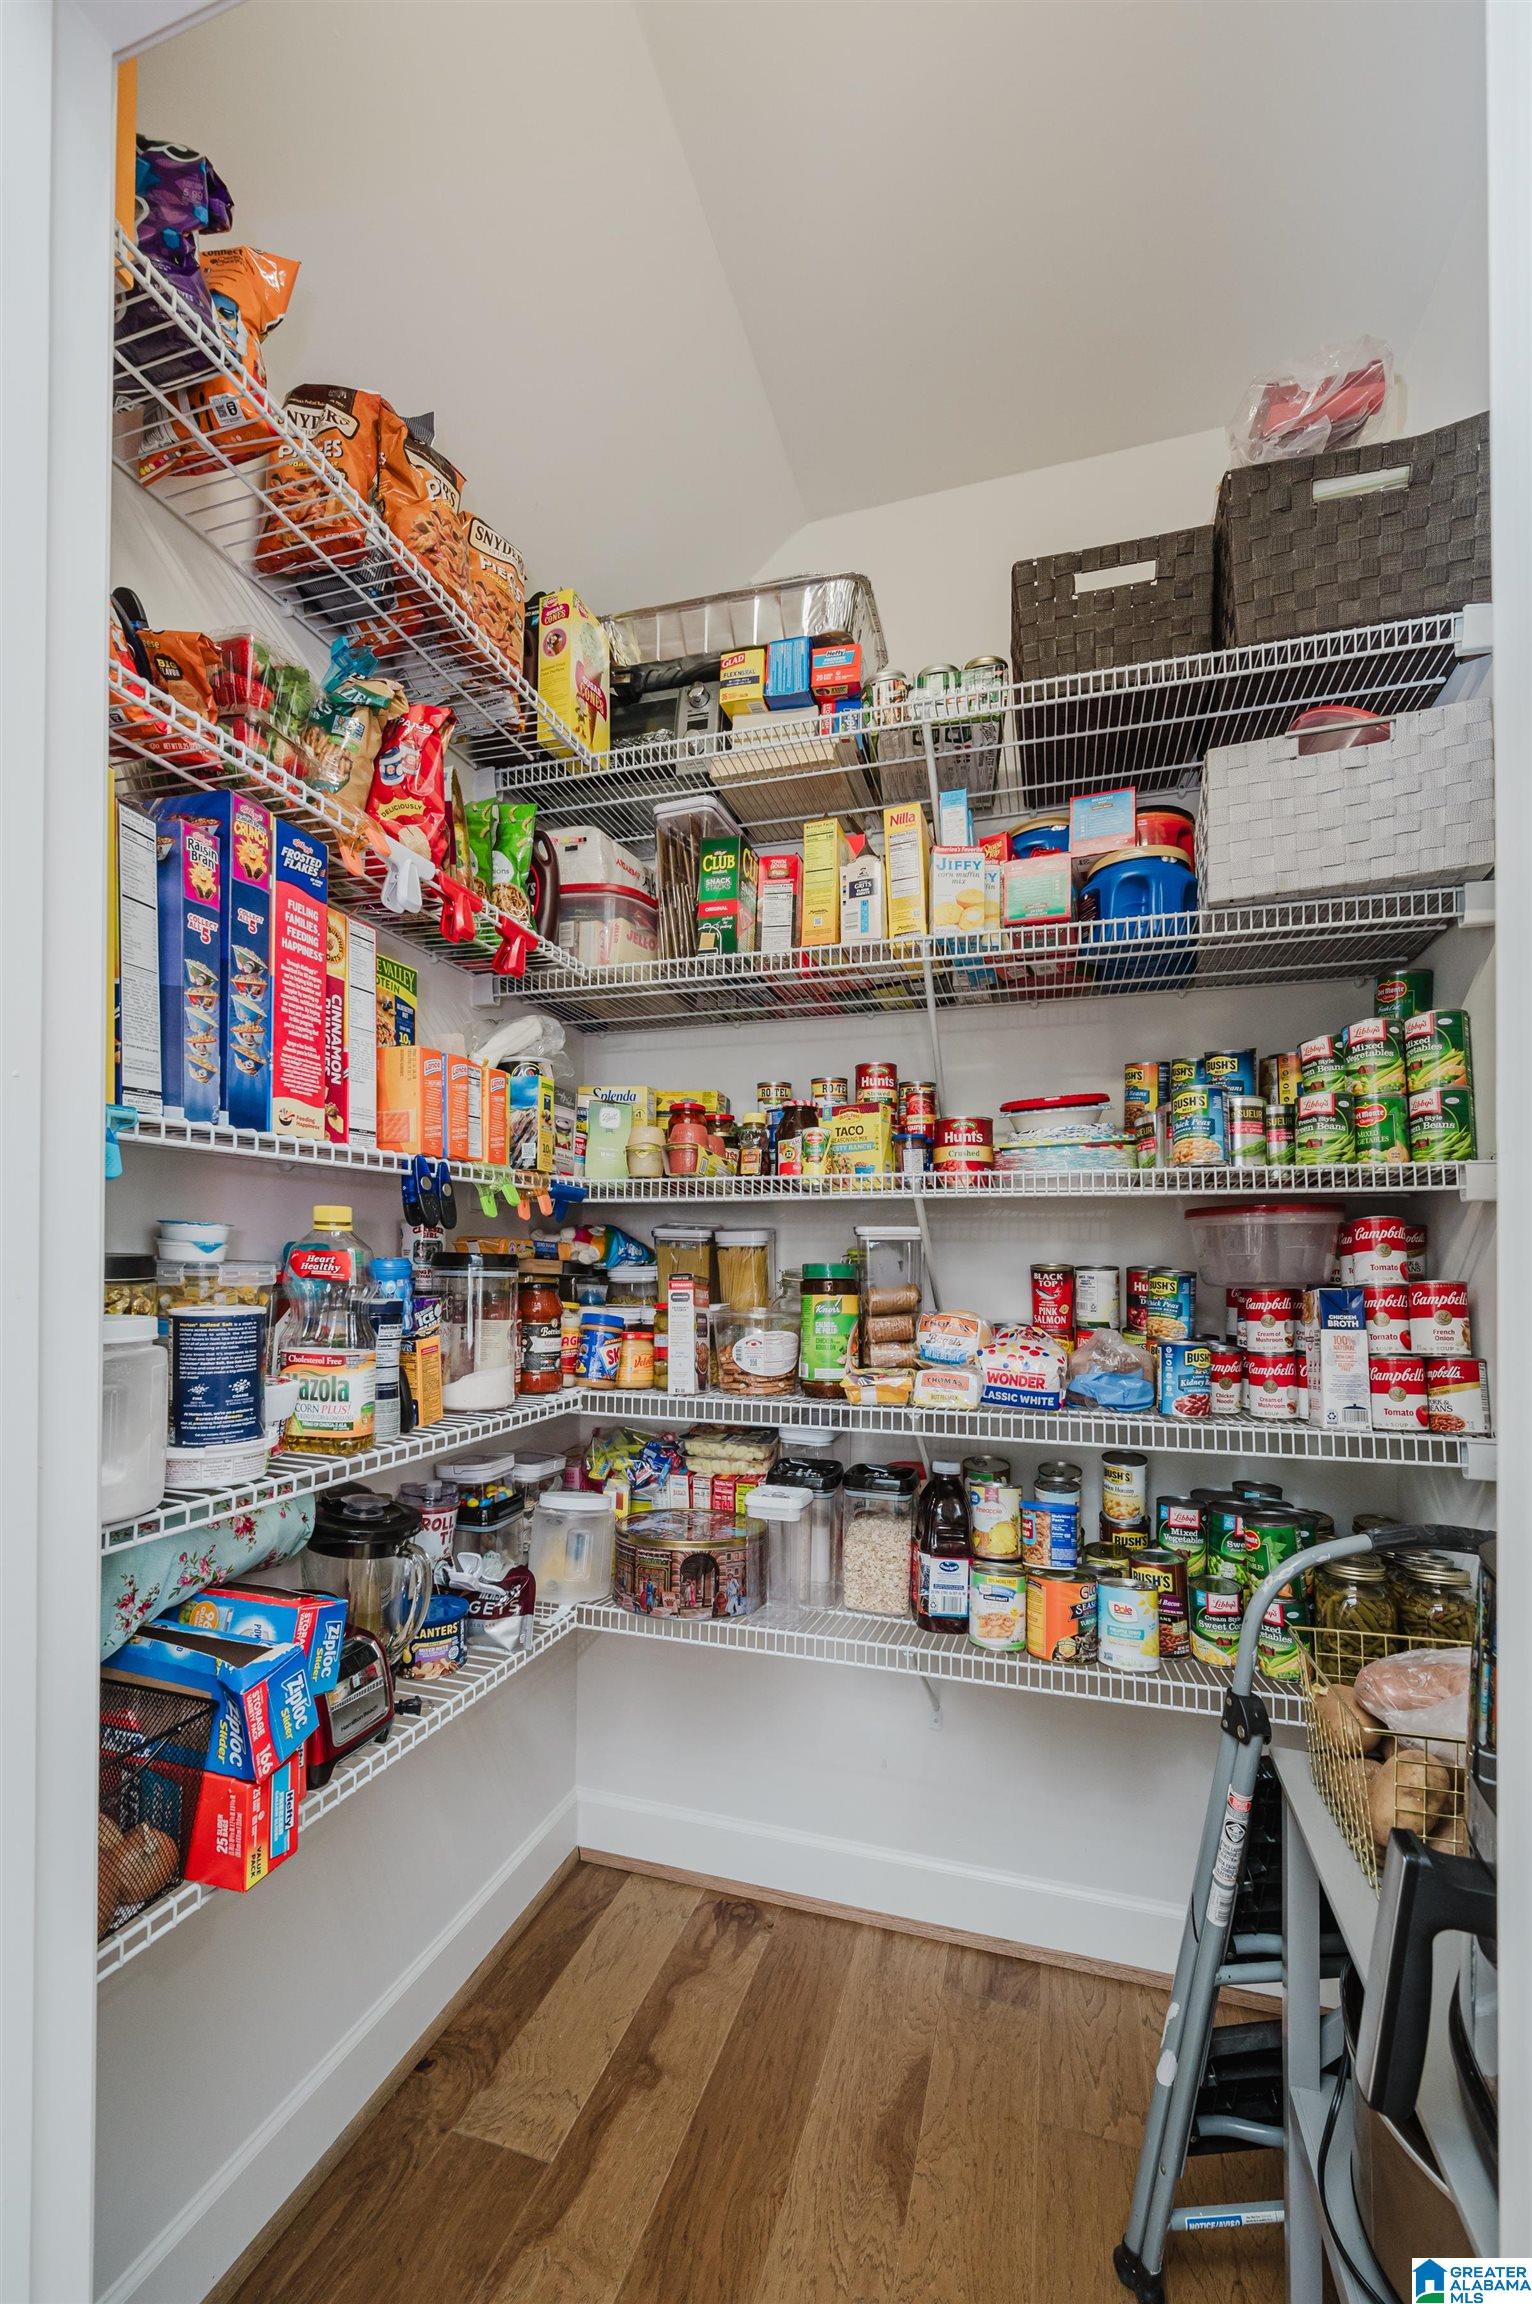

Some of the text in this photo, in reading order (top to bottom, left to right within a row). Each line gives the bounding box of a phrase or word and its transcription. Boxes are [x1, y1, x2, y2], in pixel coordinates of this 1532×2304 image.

[156, 658, 178, 669] BIG
[721, 655, 745, 668] GLAD
[381, 803, 422, 818] DELICIOUSLY
[889, 811, 916, 828] Nilla
[233, 821, 269, 849] CRUNCH
[187, 837, 218, 861] Raisin
[191, 852, 216, 870] Bran
[280, 847, 322, 868] FROSTED
[702, 854, 736, 873] CLUB
[936, 857, 983, 871] JIFFY
[283, 858, 319, 877] FLAKES
[704, 876, 732, 885] SNACK
[955, 871, 980, 880] muffin
[853, 879, 872, 890] GRITS
[238, 908, 265, 924] COLLECT
[287, 899, 320, 920] FUELING
[187, 913, 219, 932] COLLECT
[248, 921, 258, 933] 5
[200, 927, 211, 943] 5
[286, 926, 320, 948] FEEDING
[281, 937, 324, 962] HAPPINESS
[382, 960, 416, 993] VALLEY
[1385, 986, 1405, 996] Monte
[1353, 1025, 1381, 1038] Libby's
[1405, 1020, 1428, 1035] Libby's
[331, 994, 343, 1085] CINNAMON
[1303, 1044, 1326, 1056] Libby's
[1351, 1041, 1385, 1054] Mixed
[1318, 1058, 1335, 1067] Style
[1346, 1050, 1395, 1064] Vegetables
[425, 1060, 441, 1071] Lance
[452, 1066, 467, 1076] Lance
[1206, 1059, 1237, 1072] BUSH'S
[1317, 1062, 1346, 1073] Beans
[491, 1078, 506, 1089] Lance
[593, 1087, 637, 1102] Splenda
[1173, 1095, 1206, 1111] BUSH'S
[1303, 1098, 1329, 1111] Libby's
[1411, 1098, 1434, 1111] Libby's
[1318, 1115, 1336, 1123] Style
[1360, 1109, 1384, 1119] Monte
[1424, 1114, 1443, 1123] Style
[1191, 1118, 1211, 1127] Peas
[1316, 1122, 1346, 1133] Beans
[1422, 1122, 1456, 1131] Beans
[835, 1125, 864, 1137] TACO
[944, 1130, 984, 1143] Hunt's
[306, 1254, 336, 1264] Heart
[300, 1262, 341, 1273] Healthy
[1370, 1262, 1400, 1272] Tomato
[1033, 1272, 1064, 1281] BLACK
[1039, 1279, 1058, 1287] TOP
[1149, 1279, 1177, 1292] BUSH'S
[1163, 1301, 1180, 1309] Peas
[1246, 1298, 1293, 1312] Campbell's
[1364, 1294, 1408, 1309] ampbell's
[1411, 1292, 1469, 1306] Campbell's
[815, 1304, 841, 1314] Knorr
[1038, 1306, 1058, 1316] PINK
[1034, 1314, 1067, 1325] SALMON
[1327, 1320, 1360, 1329] BROTH
[1370, 1333, 1398, 1341] Tomato
[1432, 1328, 1456, 1336] French
[925, 1333, 963, 1347] Bagels
[1332, 1335, 1356, 1346] 100%
[287, 1354, 343, 1366] Cholesterol Free
[1248, 1362, 1297, 1377] Campbell's
[1370, 1366, 1425, 1383] Campbell's
[986, 1371, 1046, 1389] WONDER
[1180, 1378, 1203, 1388] Kidney
[1019, 1392, 1055, 1406] WHITE
[294, 1402, 352, 1415] CORN PLUS!
[1383, 1408, 1415, 1417] Tomato
[1104, 1468, 1132, 1482] BUSH'S
[1114, 1485, 1135, 1494] Hominy
[1174, 1512, 1197, 1522] Libby's
[1170, 1527, 1198, 1536] Mixed
[1114, 1534, 1149, 1548] BUSH'S
[1163, 1533, 1204, 1544] Vegetables
[1132, 1570, 1171, 1589] BUSH'S
[1113, 1605, 1133, 1616] Dole
[1213, 1600, 1237, 1609] Libby's
[1204, 1614, 1228, 1622] Cream
[1198, 1620, 1226, 1630] Sweet
[320, 1624, 342, 1679] Ziploc
[311, 1647, 324, 1682] Slider
[284, 1674, 309, 1731] Ziploc
[250, 1689, 266, 1738] STORAGE
[341, 1704, 378, 1732] Hamilton Beach
[279, 1707, 294, 1740] Slider
[225, 1697, 244, 1769] Ziploc
[217, 1719, 229, 1766] Slider
[260, 1743, 275, 1776] 166
[284, 1790, 295, 1831] Hefty
[216, 1836, 229, 1855] 25
[255, 1846, 263, 1875] VALUE
